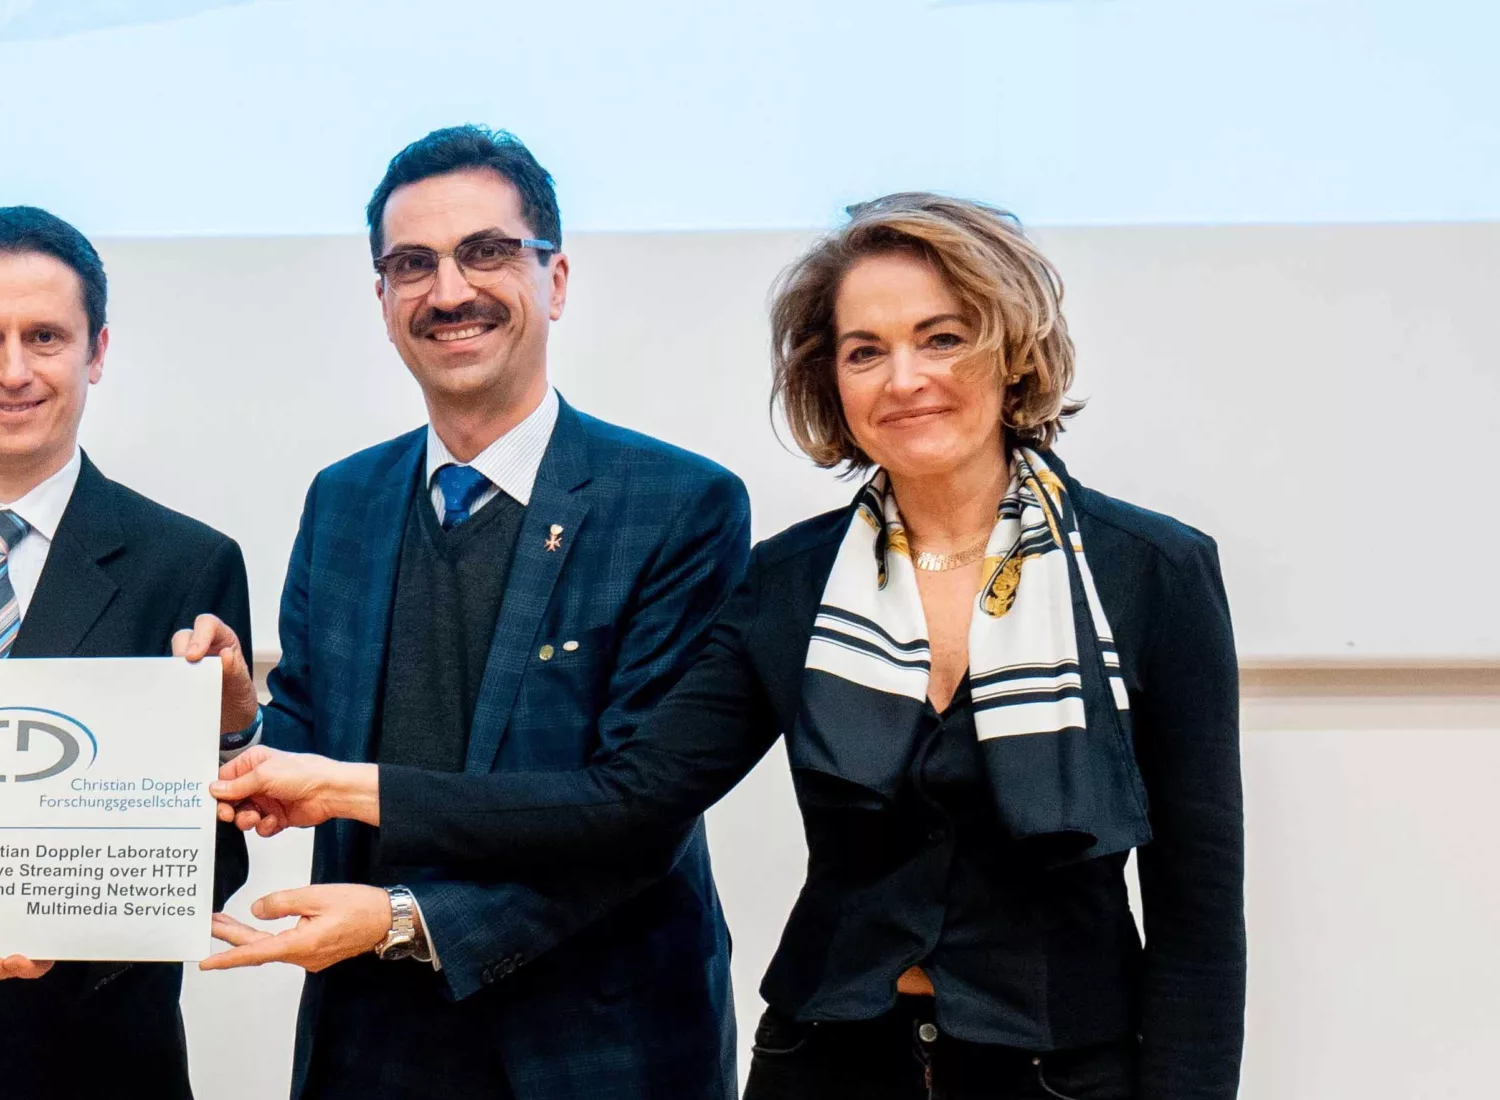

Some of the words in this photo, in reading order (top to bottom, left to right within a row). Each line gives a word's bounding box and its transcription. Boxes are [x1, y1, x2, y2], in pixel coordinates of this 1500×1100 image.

[70, 777, 136, 791] Christian
[141, 777, 203, 795] Doppler
[39, 794, 202, 812] Forschungsgesellschaft
[36, 844, 103, 862] Doppler
[107, 844, 199, 863] Laboratory
[19, 863, 104, 881] Streaming
[109, 867, 148, 878] over
[152, 863, 198, 878] HTTP
[20, 882, 101, 900] Emerging
[106, 882, 197, 897] Networked
[26, 901, 118, 916] Multimedia
[123, 901, 196, 917] Services
